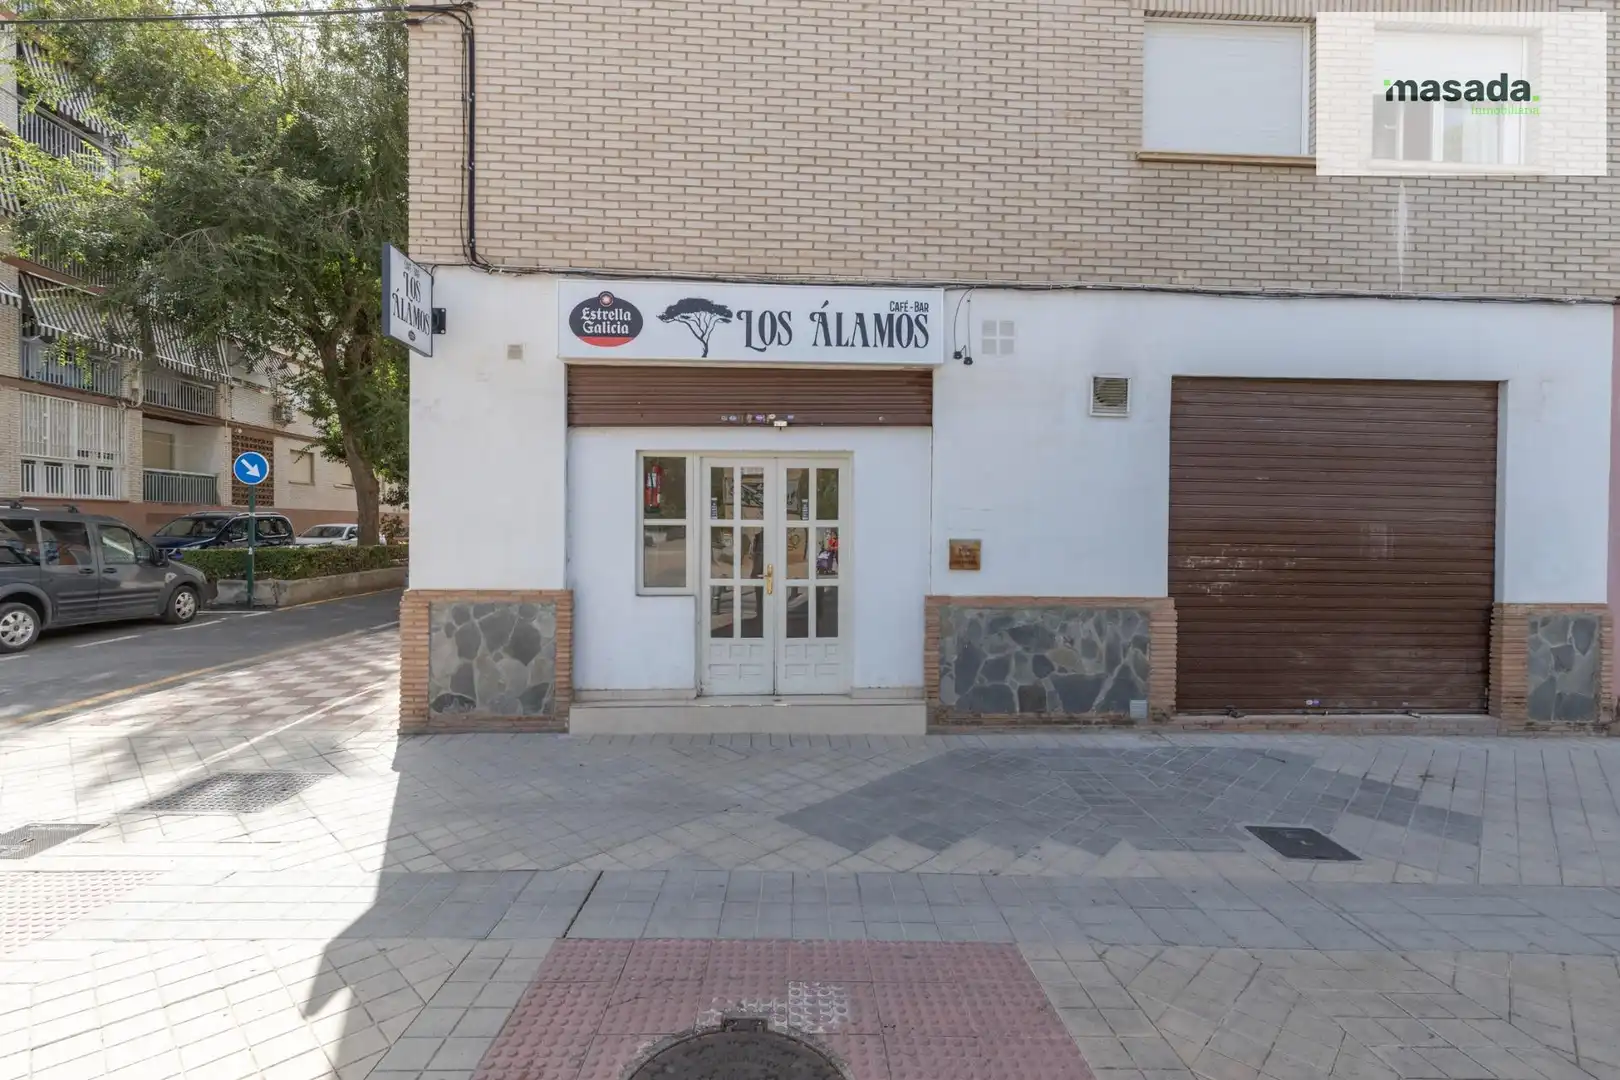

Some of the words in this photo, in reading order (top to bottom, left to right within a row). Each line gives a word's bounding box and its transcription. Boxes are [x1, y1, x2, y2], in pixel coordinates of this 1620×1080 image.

[403, 271, 421, 302] LOS
[392, 288, 430, 336] ÁLAMOS
[581, 307, 632, 321] Estrella
[582, 321, 630, 334] Galicia
[736, 310, 793, 352] LOS
[809, 300, 930, 349] ÁLAMOS
